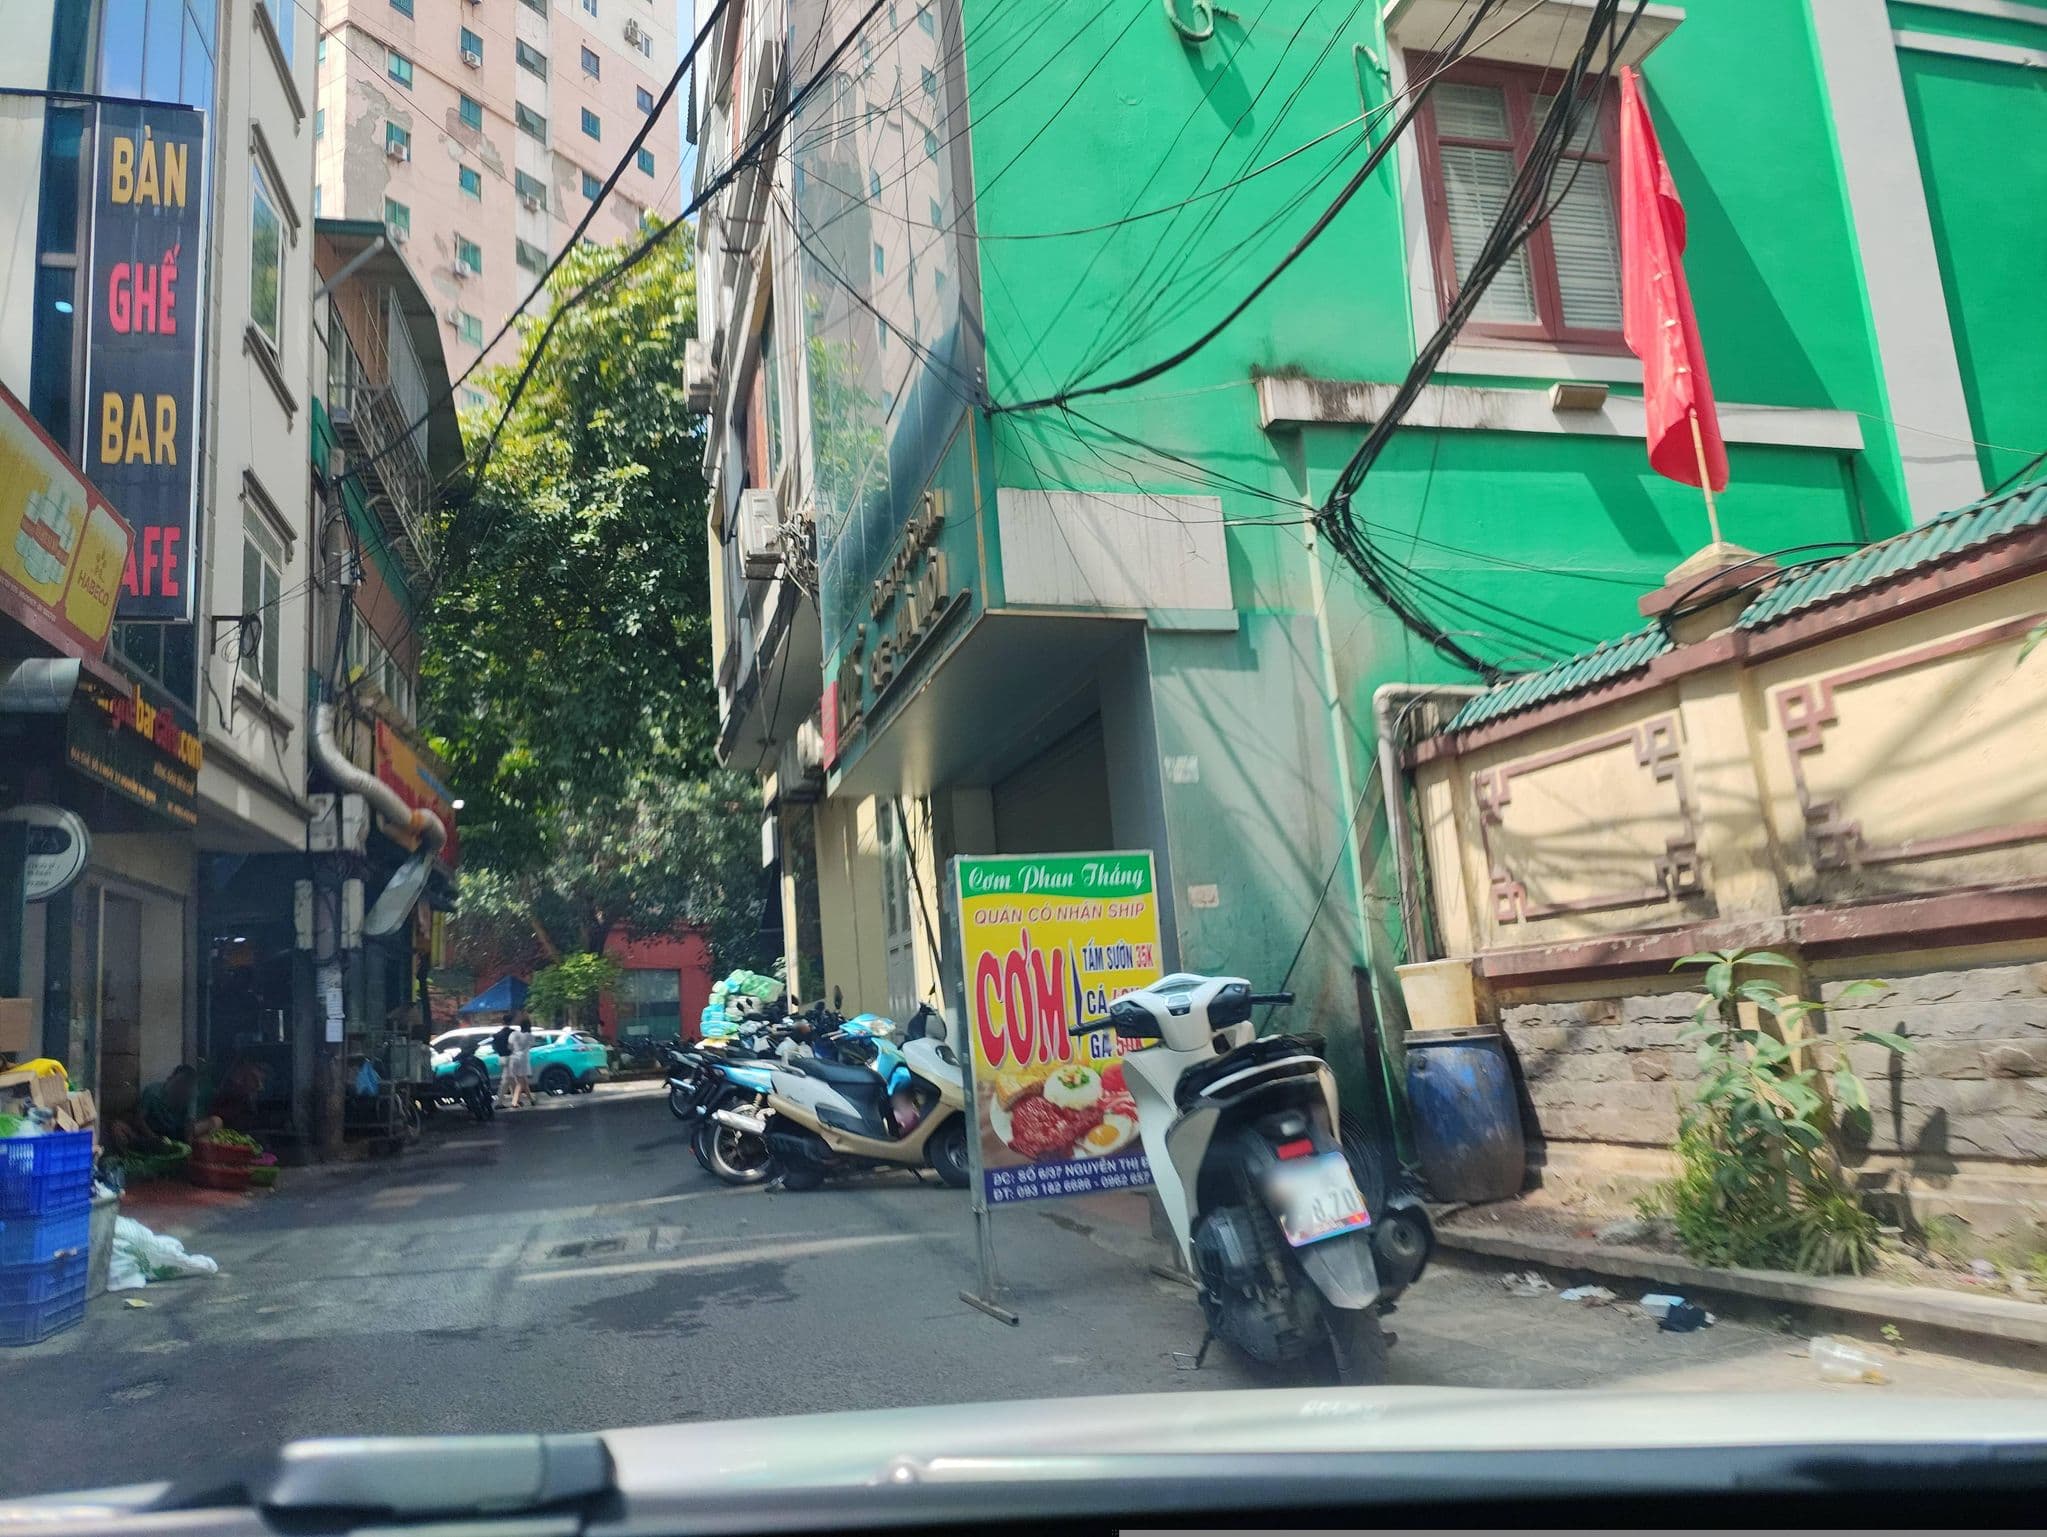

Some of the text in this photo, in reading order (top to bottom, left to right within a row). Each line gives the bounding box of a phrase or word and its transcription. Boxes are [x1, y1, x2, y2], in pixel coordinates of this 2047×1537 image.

[111, 125, 188, 208] BÀN
[108, 242, 181, 335] GHẾ
[101, 391, 177, 466] BAR
[122, 525, 180, 596] AFE
[77, 570, 110, 607] HABECO
[968, 866, 1012, 892] Cơm
[1017, 864, 1074, 894] Phan
[975, 902, 1145, 925] QUÁN CÓ NHẬN SHIP
[1135, 943, 1154, 968] 35K
[976, 927, 1072, 1067] CƠM
[1087, 984, 1108, 1014] CÁ
[1017, 1164, 1037, 1183] SỐ
